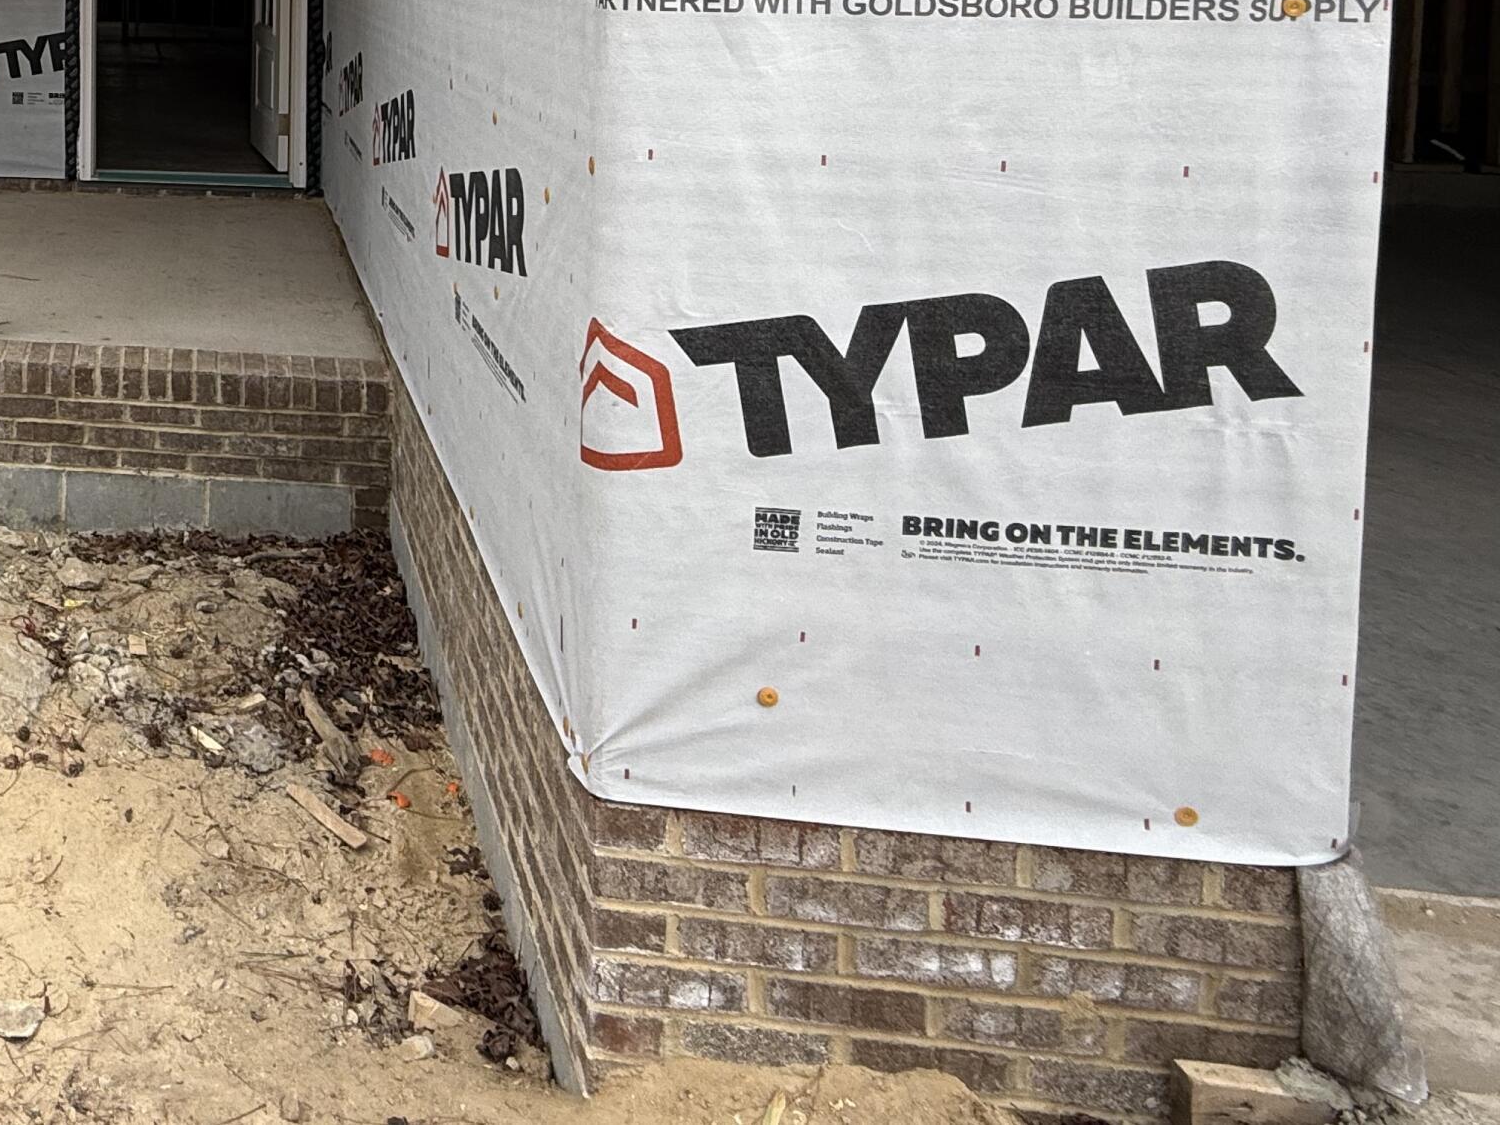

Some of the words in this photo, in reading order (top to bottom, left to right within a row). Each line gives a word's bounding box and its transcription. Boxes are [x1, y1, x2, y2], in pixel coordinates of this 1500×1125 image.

[381, 89, 416, 163] TYPAR
[450, 167, 527, 277] TYPAR
[668, 260, 1304, 458] TYPAR
[755, 513, 800, 525] MADE
[817, 511, 848, 520] Building
[850, 513, 874, 522] Wraps
[817, 523, 852, 532] Flashings
[754, 528, 769, 538] IN
[770, 530, 799, 540] OLD
[902, 515, 1000, 542] BRING
[1005, 522, 1050, 545] ON
[1056, 525, 1118, 549] THE
[1123, 529, 1305, 562] ELEMENTS.
[816, 535, 864, 545] Construction
[865, 538, 884, 547] Tape
[815, 547, 845, 555] Sealant
